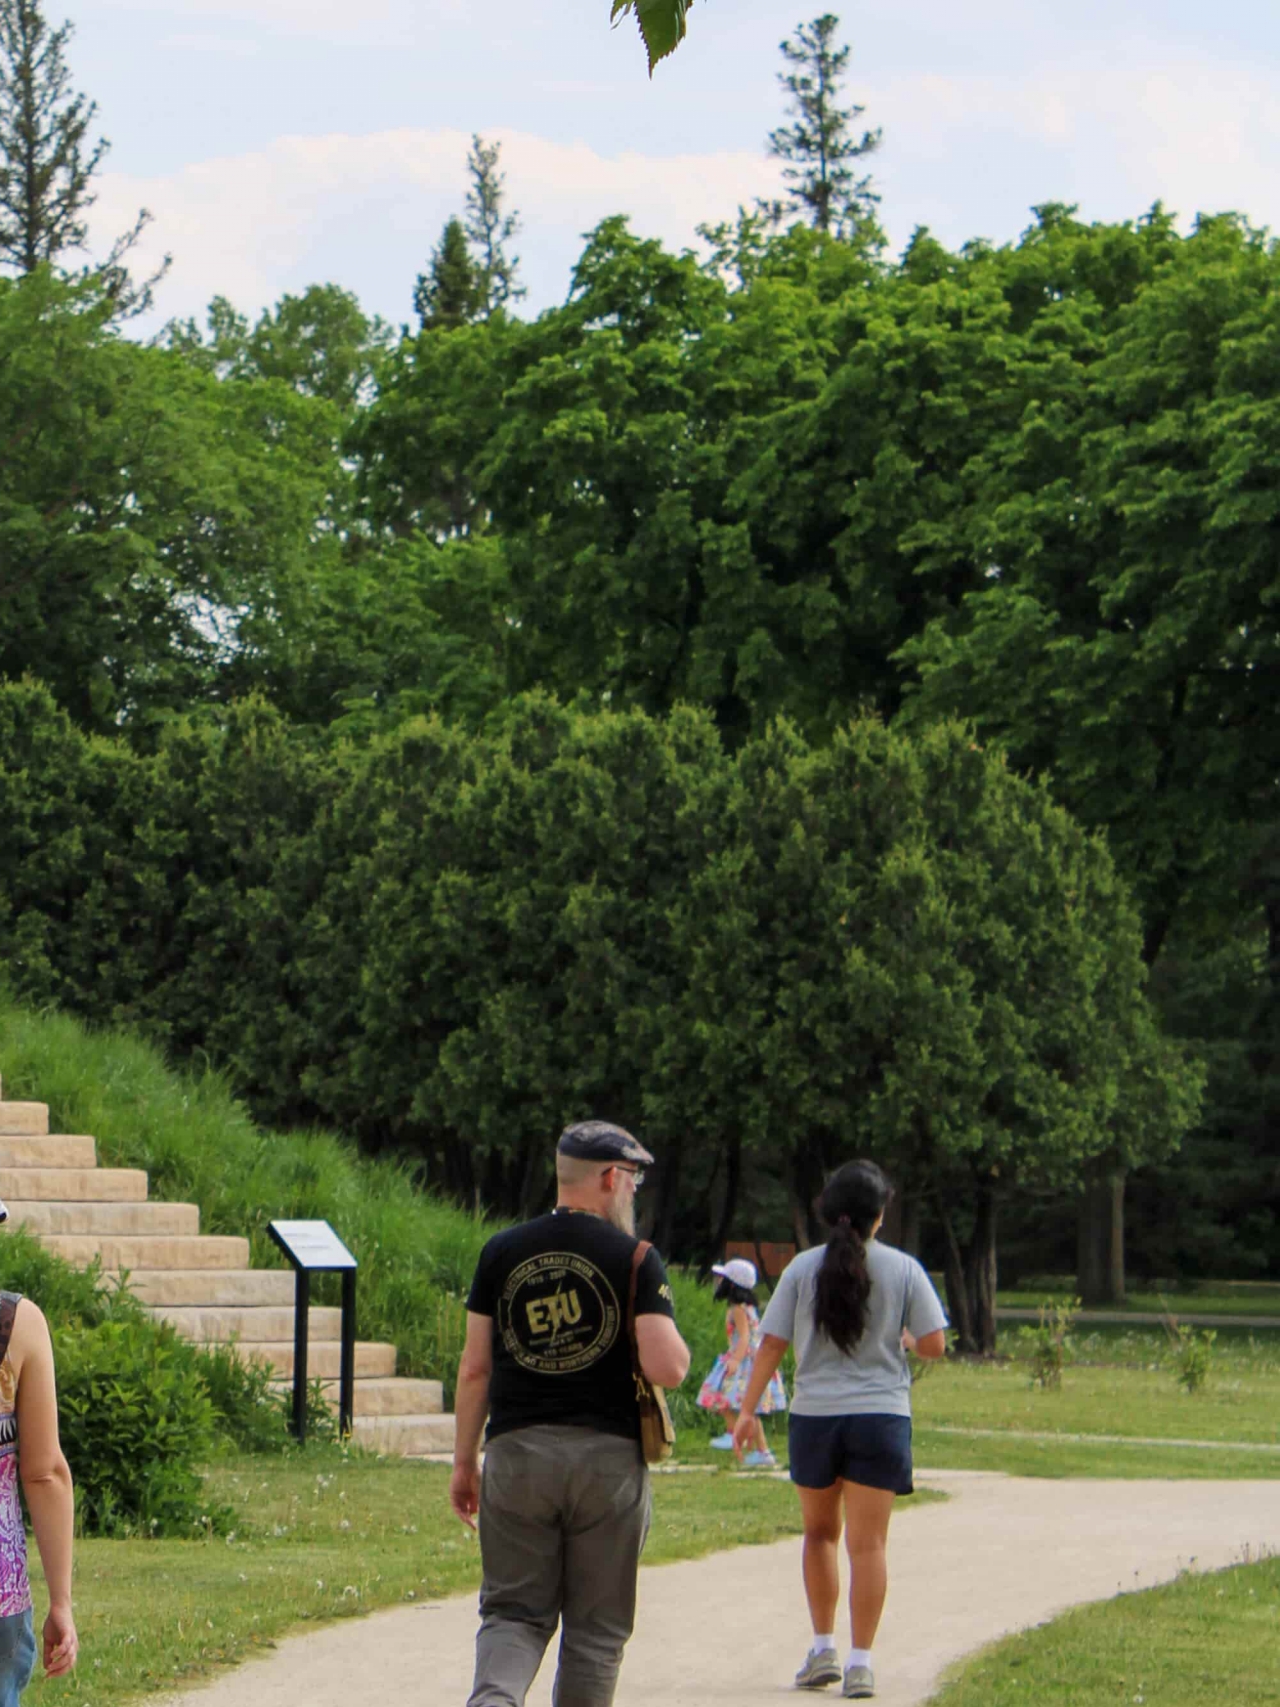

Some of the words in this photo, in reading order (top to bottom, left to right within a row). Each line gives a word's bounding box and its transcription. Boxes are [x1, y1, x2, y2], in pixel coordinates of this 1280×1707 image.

[538, 1257, 571, 1268] TRADES
[571, 1258, 595, 1278] UNION
[525, 1289, 582, 1335] ETU
[538, 1360, 557, 1370] AND
